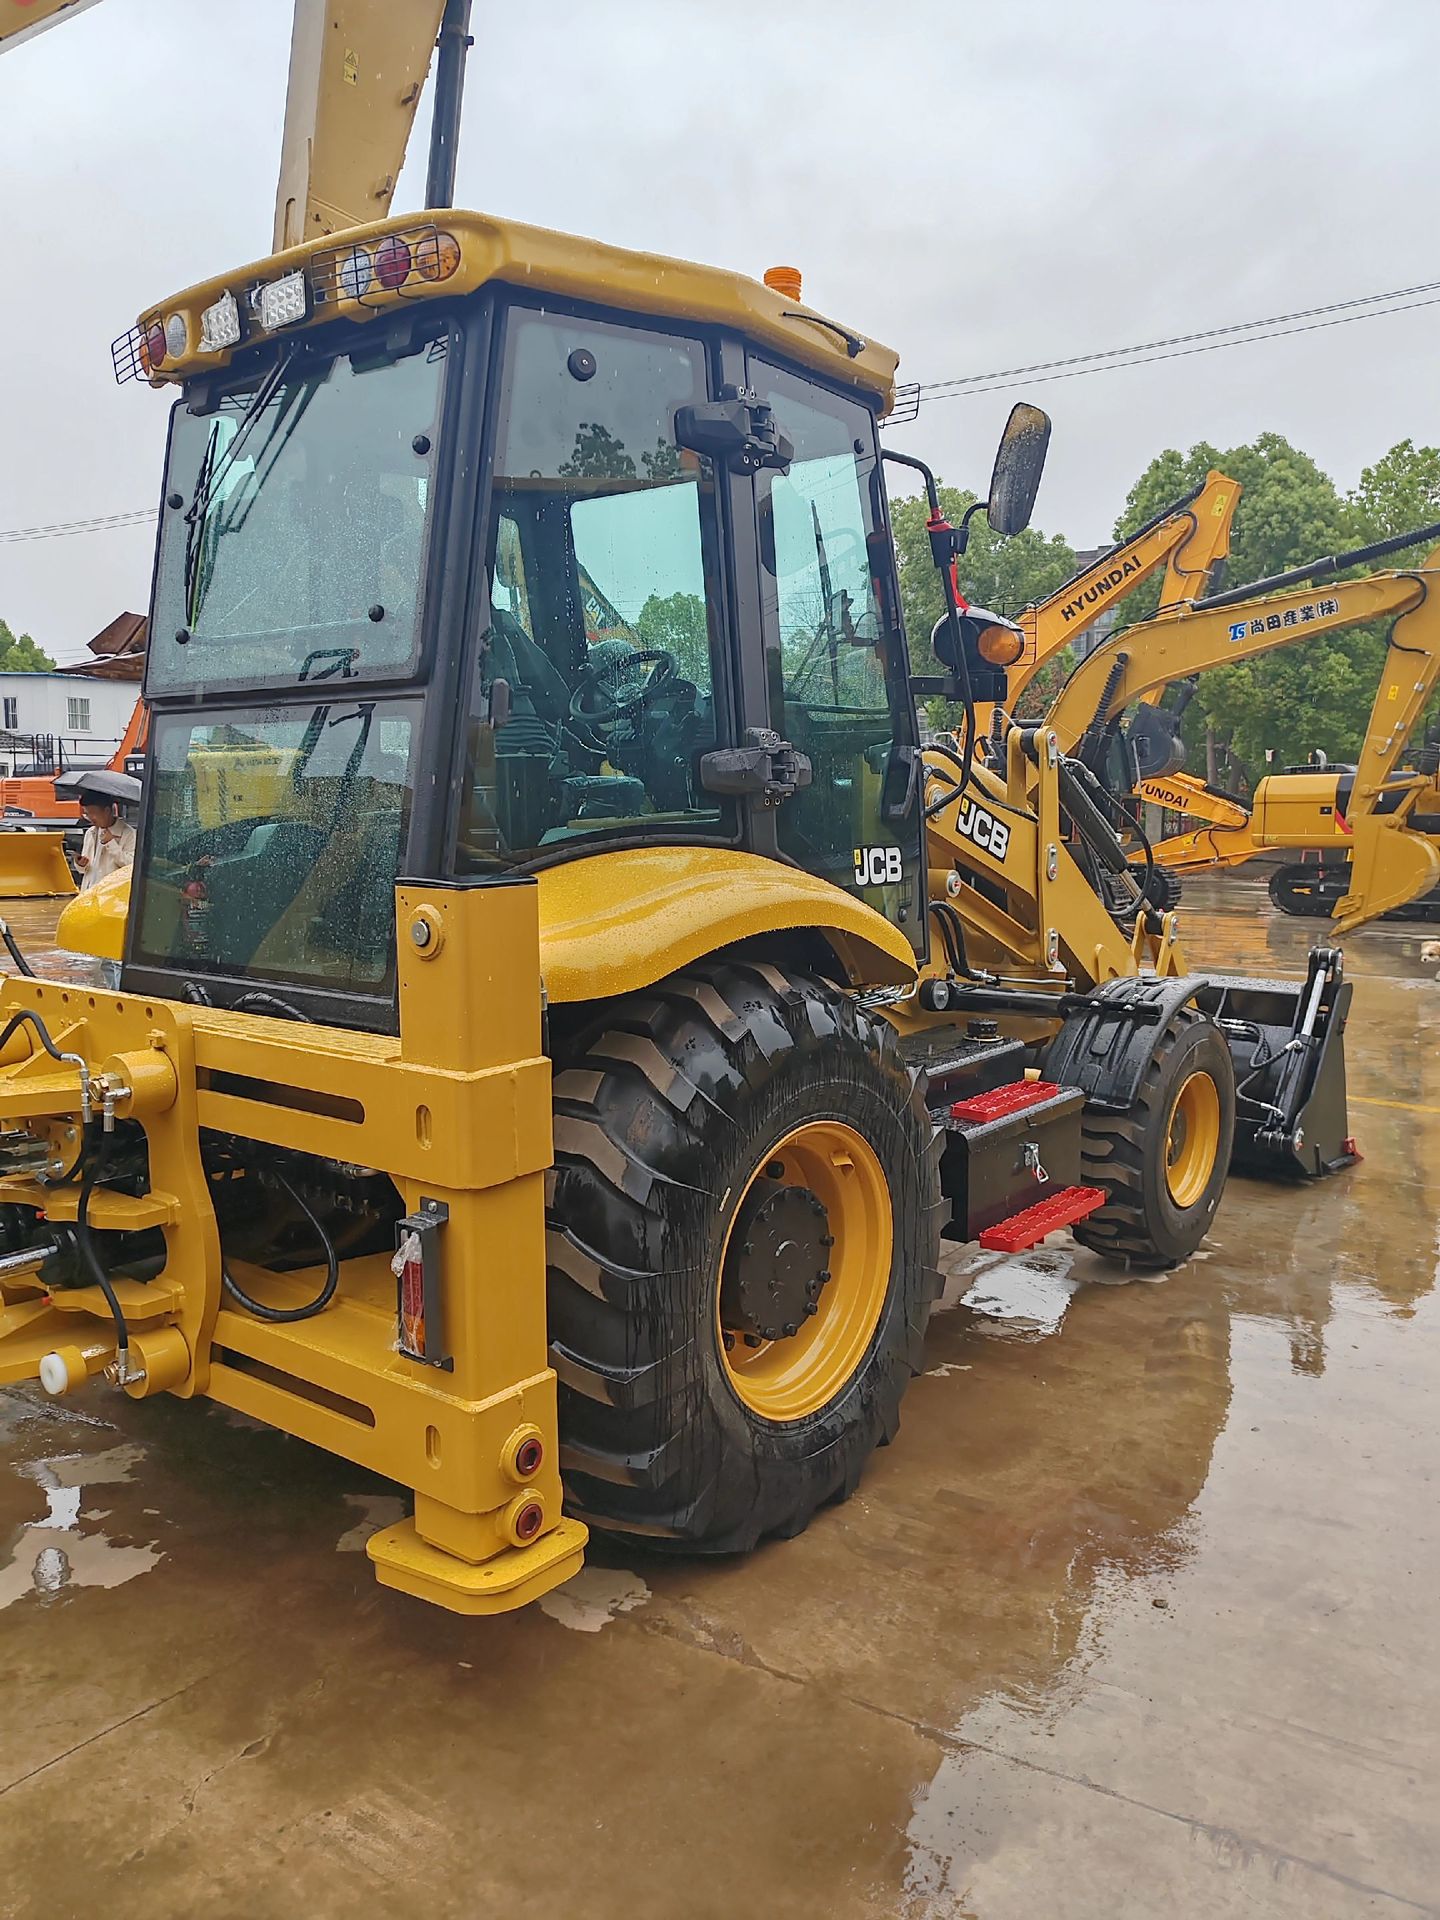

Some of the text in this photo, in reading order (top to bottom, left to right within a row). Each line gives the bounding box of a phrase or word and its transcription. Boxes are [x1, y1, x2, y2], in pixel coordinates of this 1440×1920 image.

[1060, 555, 1142, 622] HYUNDAI
[1228, 622, 1248, 641] TS
[1131, 782, 1189, 808] UNDAI
[957, 797, 1010, 860] JCB
[854, 847, 903, 886] JCB
